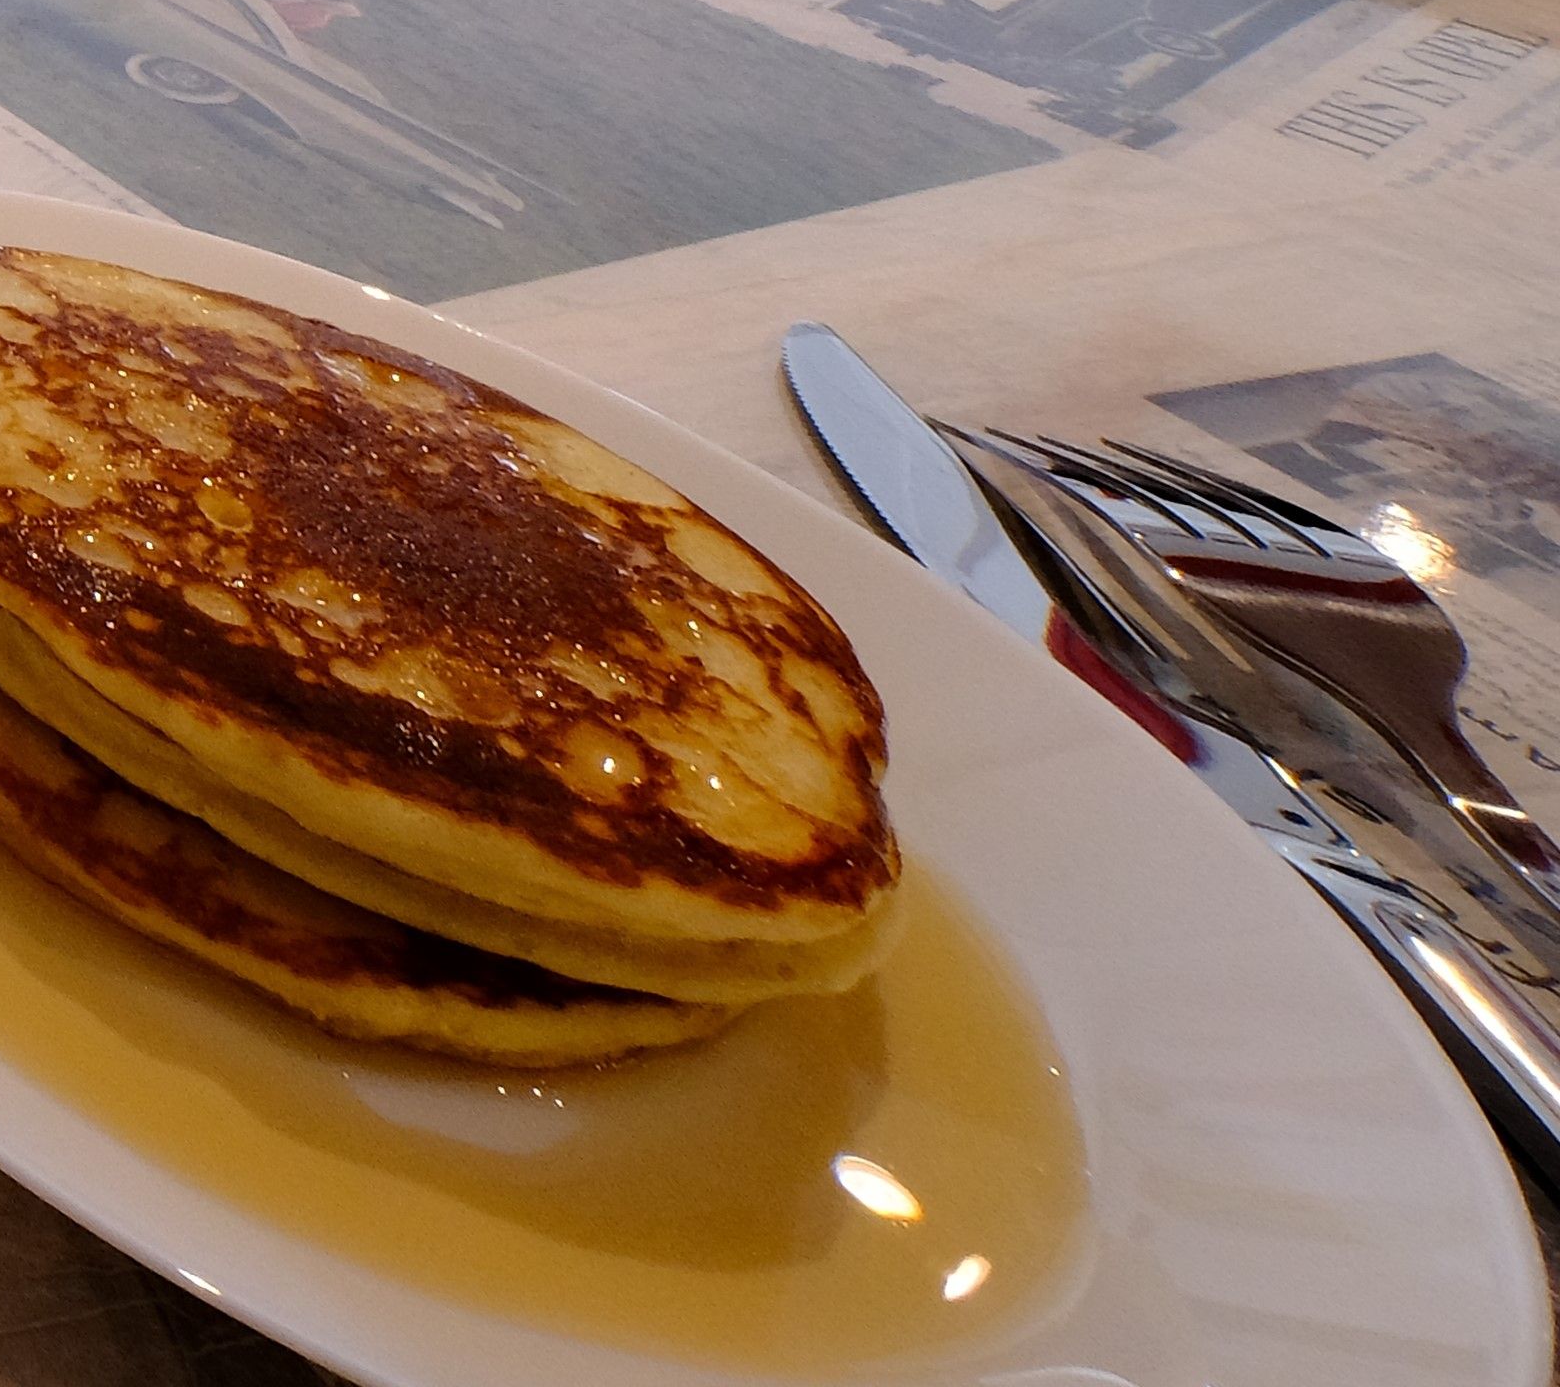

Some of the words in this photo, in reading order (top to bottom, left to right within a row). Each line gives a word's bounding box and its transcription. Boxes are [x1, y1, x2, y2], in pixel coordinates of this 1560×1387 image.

[1403, 18, 1550, 81] OPEL
[1361, 66, 1467, 108] IS
[1274, 90, 1428, 159] THIS
